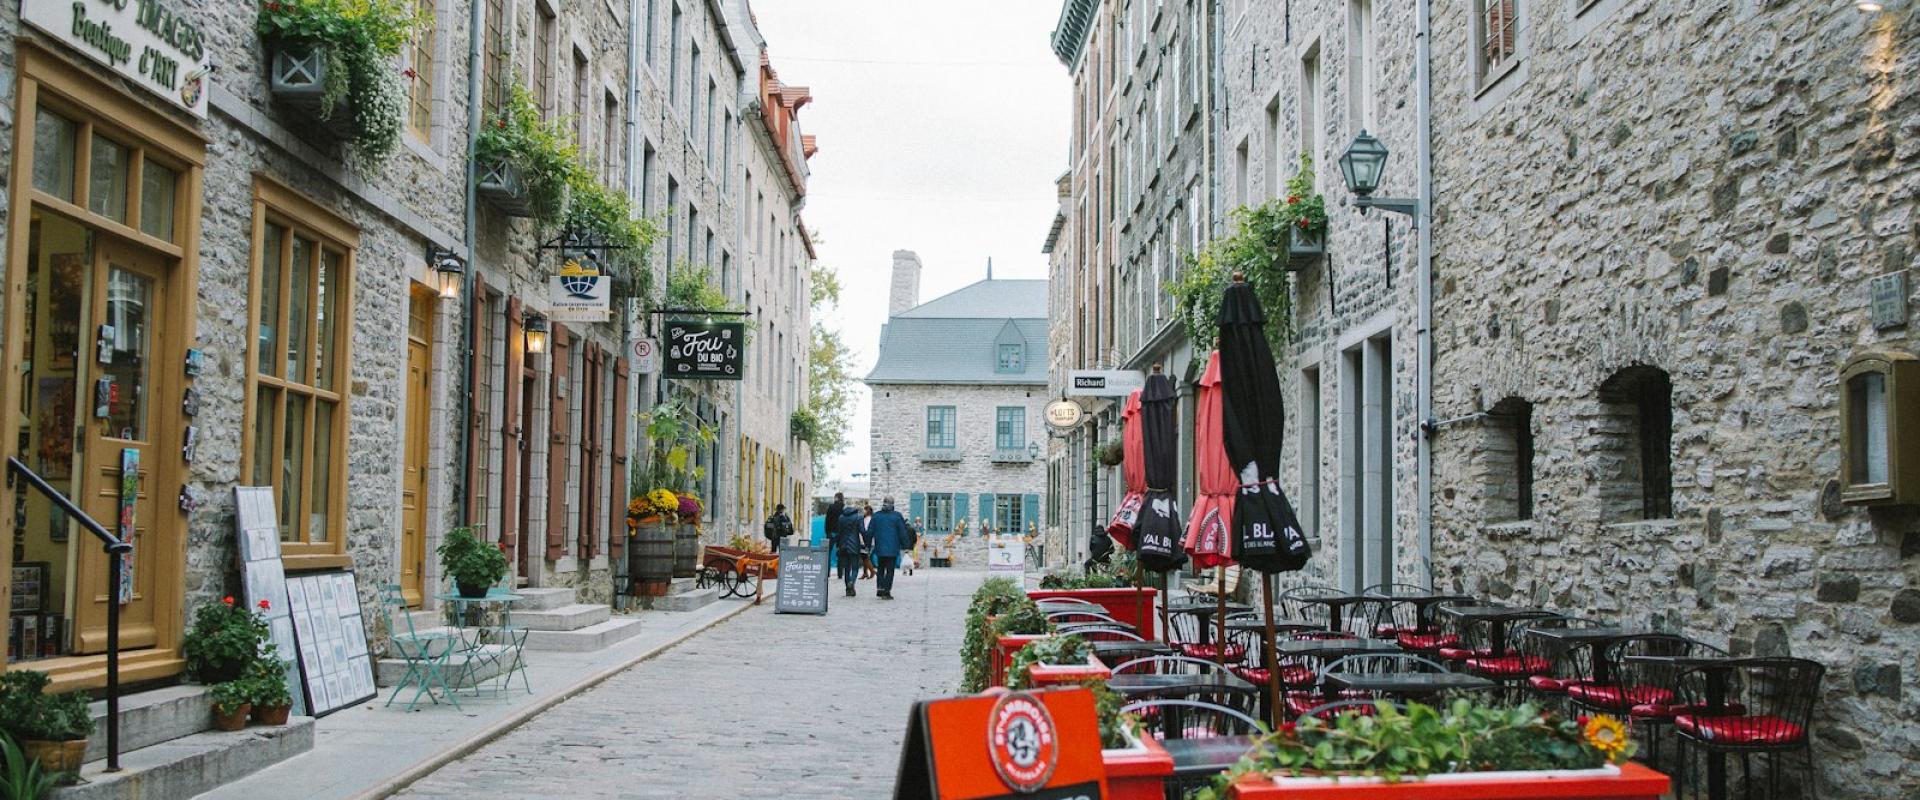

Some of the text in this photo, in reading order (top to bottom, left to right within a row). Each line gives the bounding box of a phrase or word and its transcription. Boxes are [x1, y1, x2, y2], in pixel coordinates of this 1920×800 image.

[136, 0, 206, 62] IMAGES
[73, 1, 179, 91] Boutique d'ART
[683, 330, 723, 356] Fou
[697, 353, 723, 362] DU BIO
[1253, 523, 1275, 538] BL
